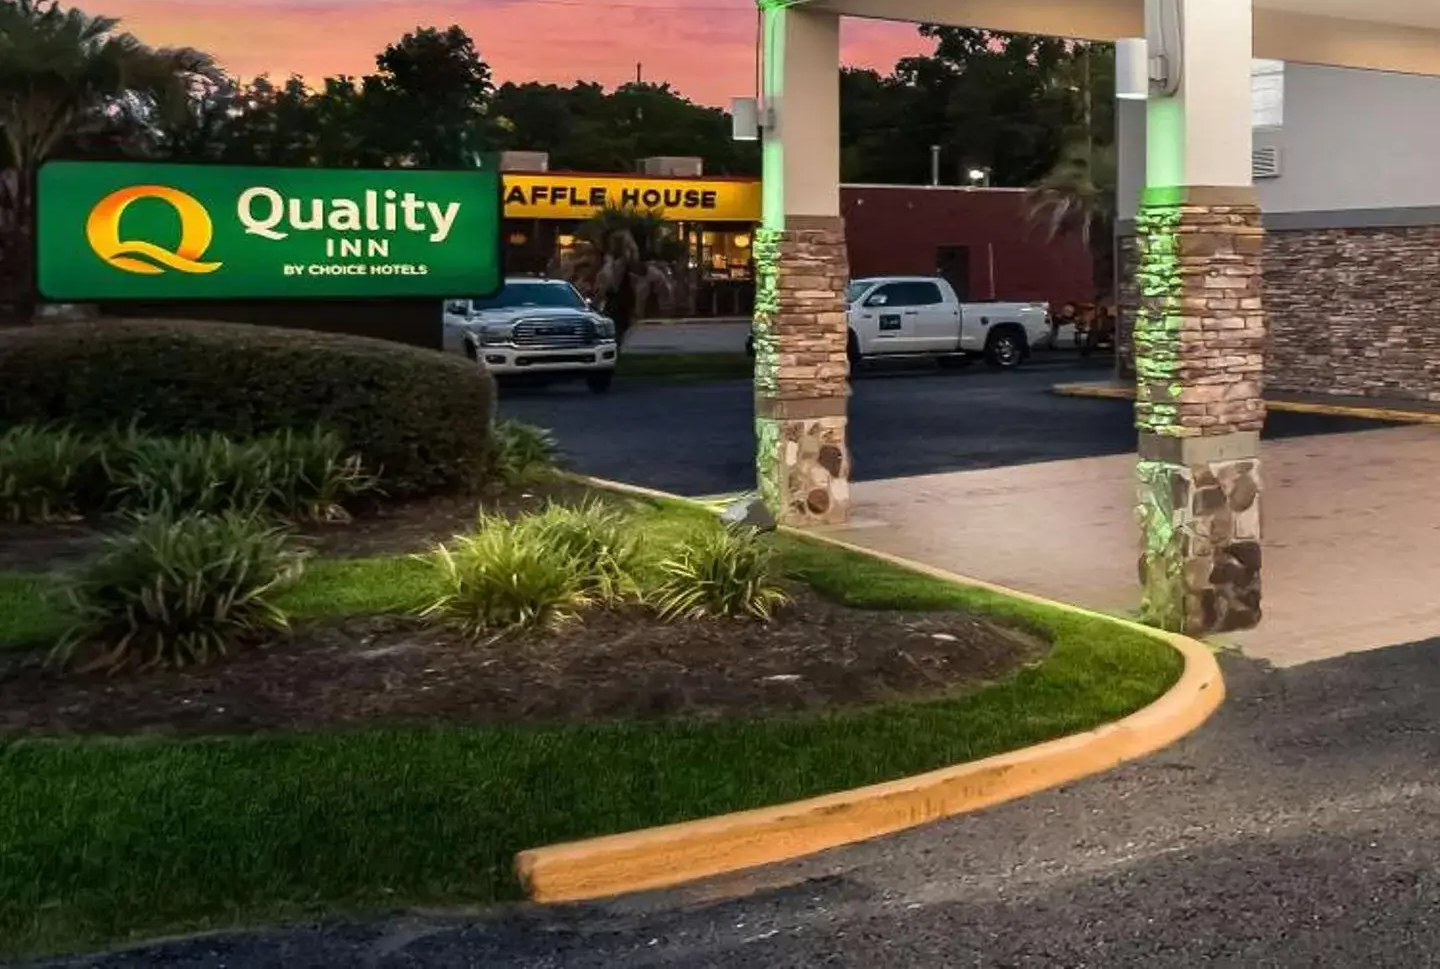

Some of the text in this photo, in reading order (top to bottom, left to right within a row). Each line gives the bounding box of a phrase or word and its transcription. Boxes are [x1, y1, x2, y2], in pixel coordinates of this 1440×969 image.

[503, 184, 717, 209] AFFLE HOUSE
[237, 186, 461, 242] Quality
[326, 238, 389, 258] INN
[283, 264, 429, 276] BY CHOICE HOTELS
